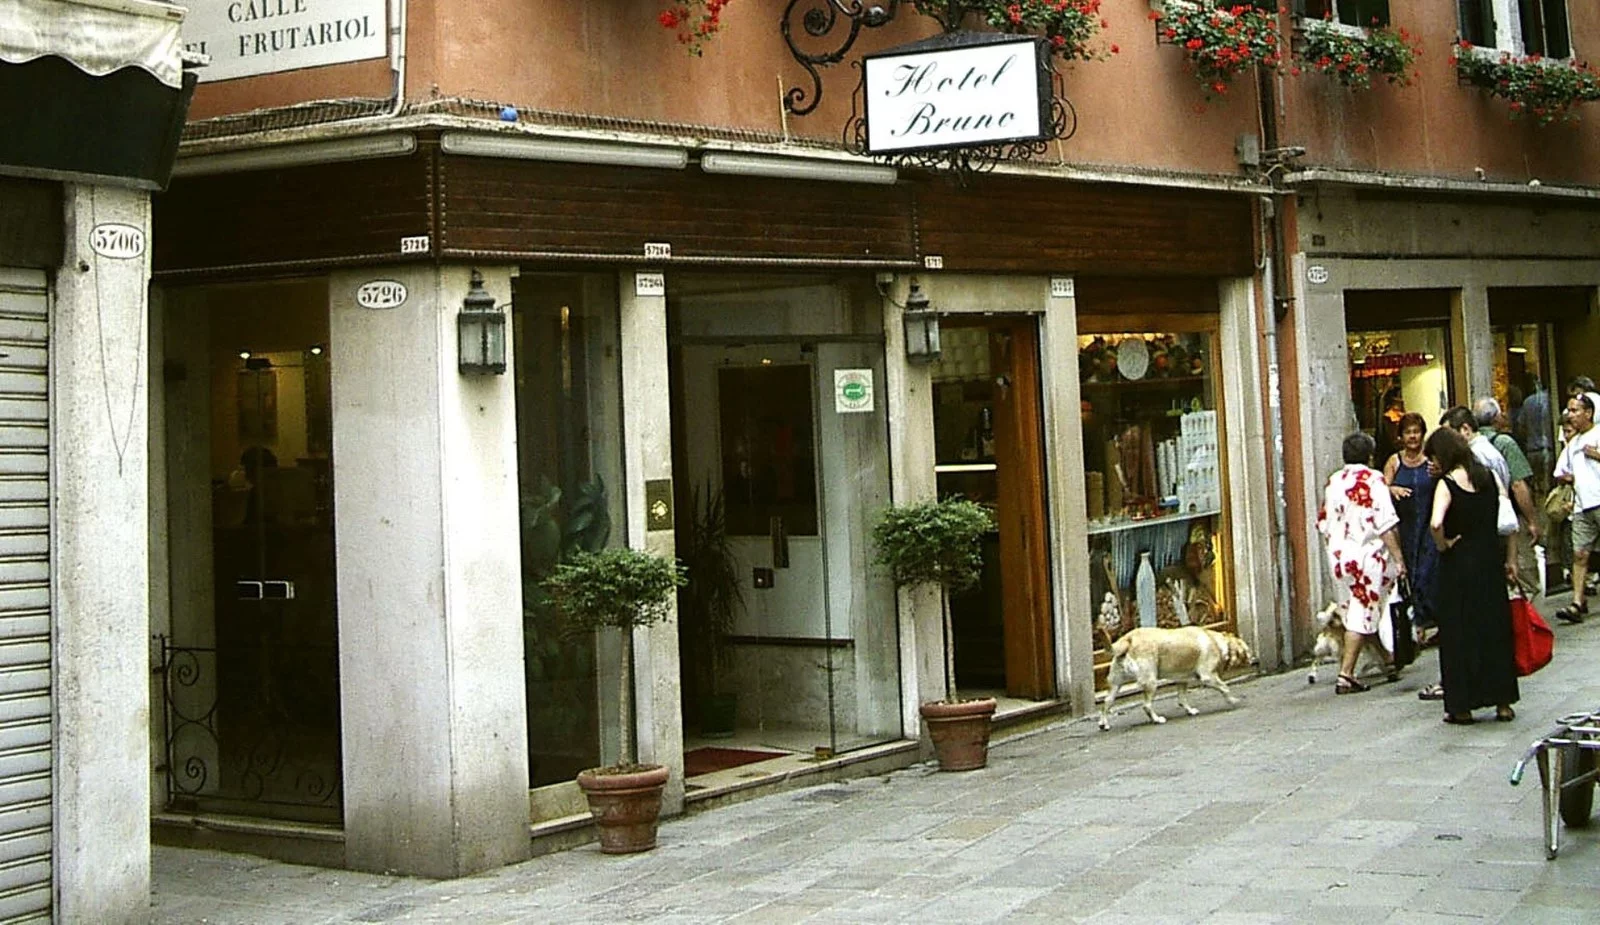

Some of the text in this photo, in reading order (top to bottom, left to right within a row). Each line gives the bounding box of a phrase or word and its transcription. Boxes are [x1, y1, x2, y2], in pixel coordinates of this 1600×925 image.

[227, 0, 307, 23] CALLE
[239, 15, 376, 57] FRUTARIOL
[884, 53, 1018, 98] Hotel
[890, 102, 1015, 138] Bruno
[96, 229, 140, 253] 5706
[403, 239, 426, 251] 5726
[362, 285, 402, 304] 5726
